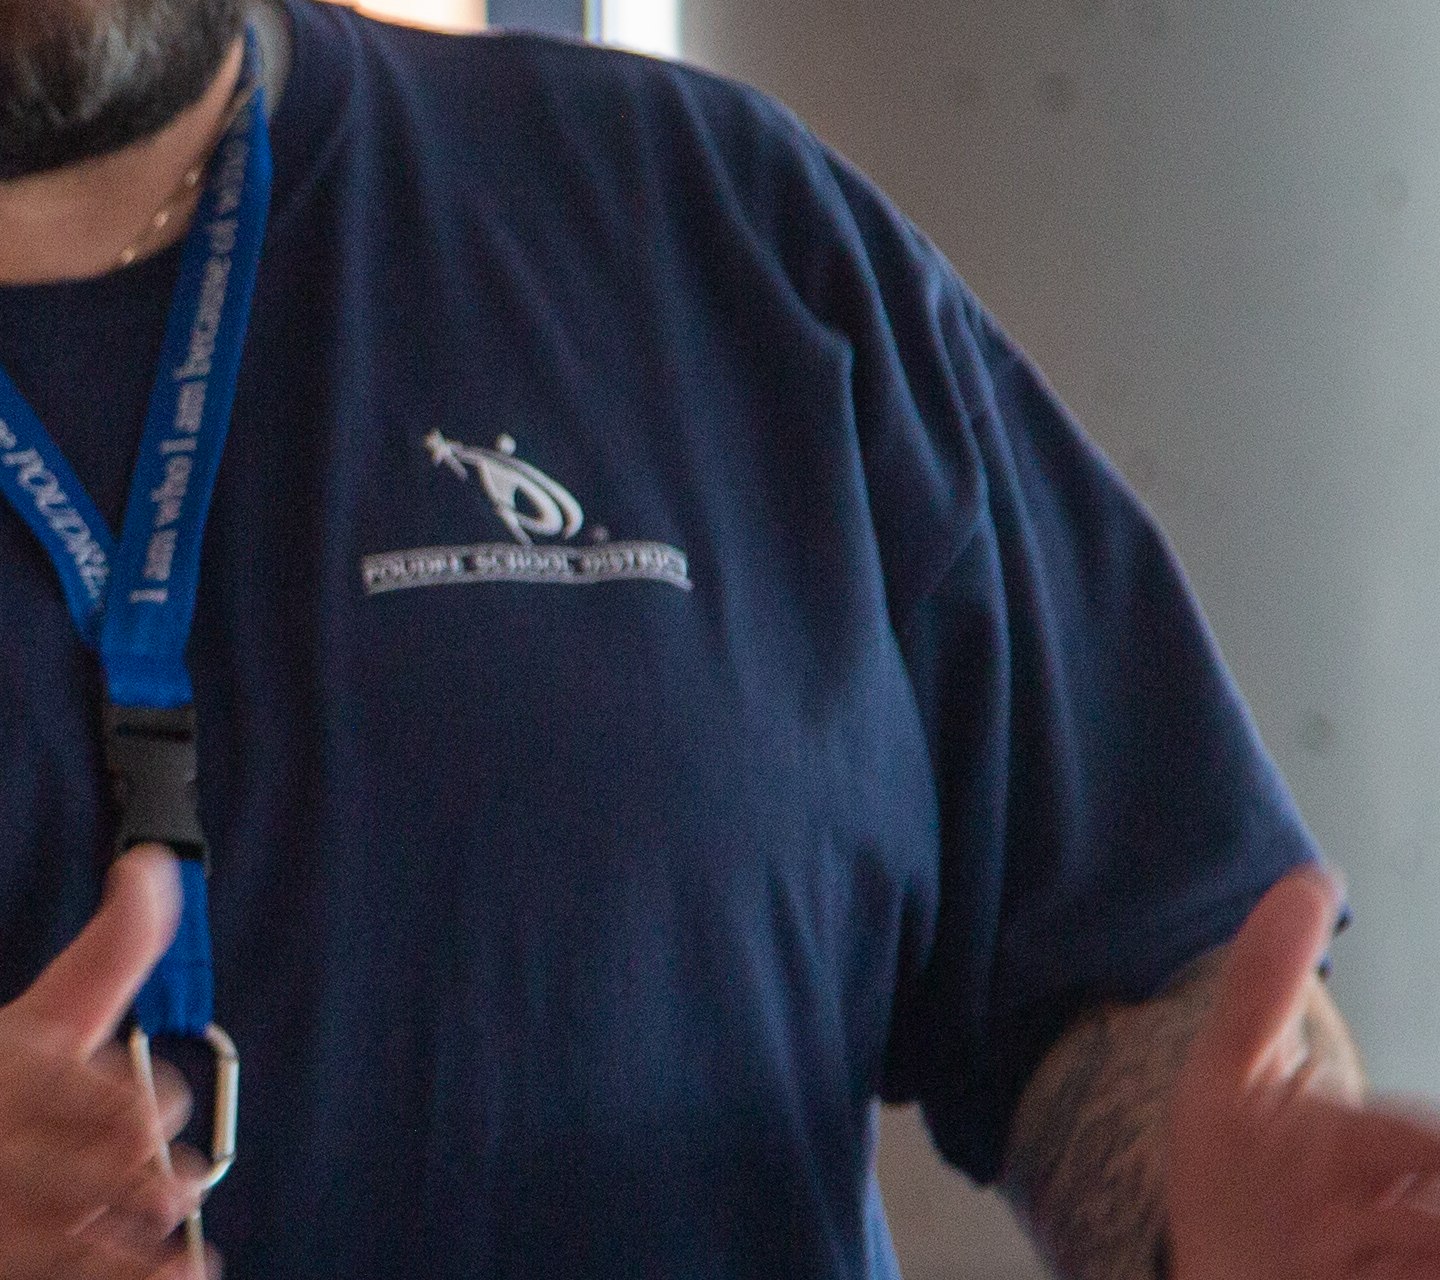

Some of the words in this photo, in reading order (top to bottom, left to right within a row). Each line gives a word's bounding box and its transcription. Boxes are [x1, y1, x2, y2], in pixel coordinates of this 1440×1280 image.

[173, 254, 232, 382] because
[173, 380, 209, 433] am
[151, 453, 195, 529] who
[141, 528, 179, 582] am
[127, 587, 170, 605] I
